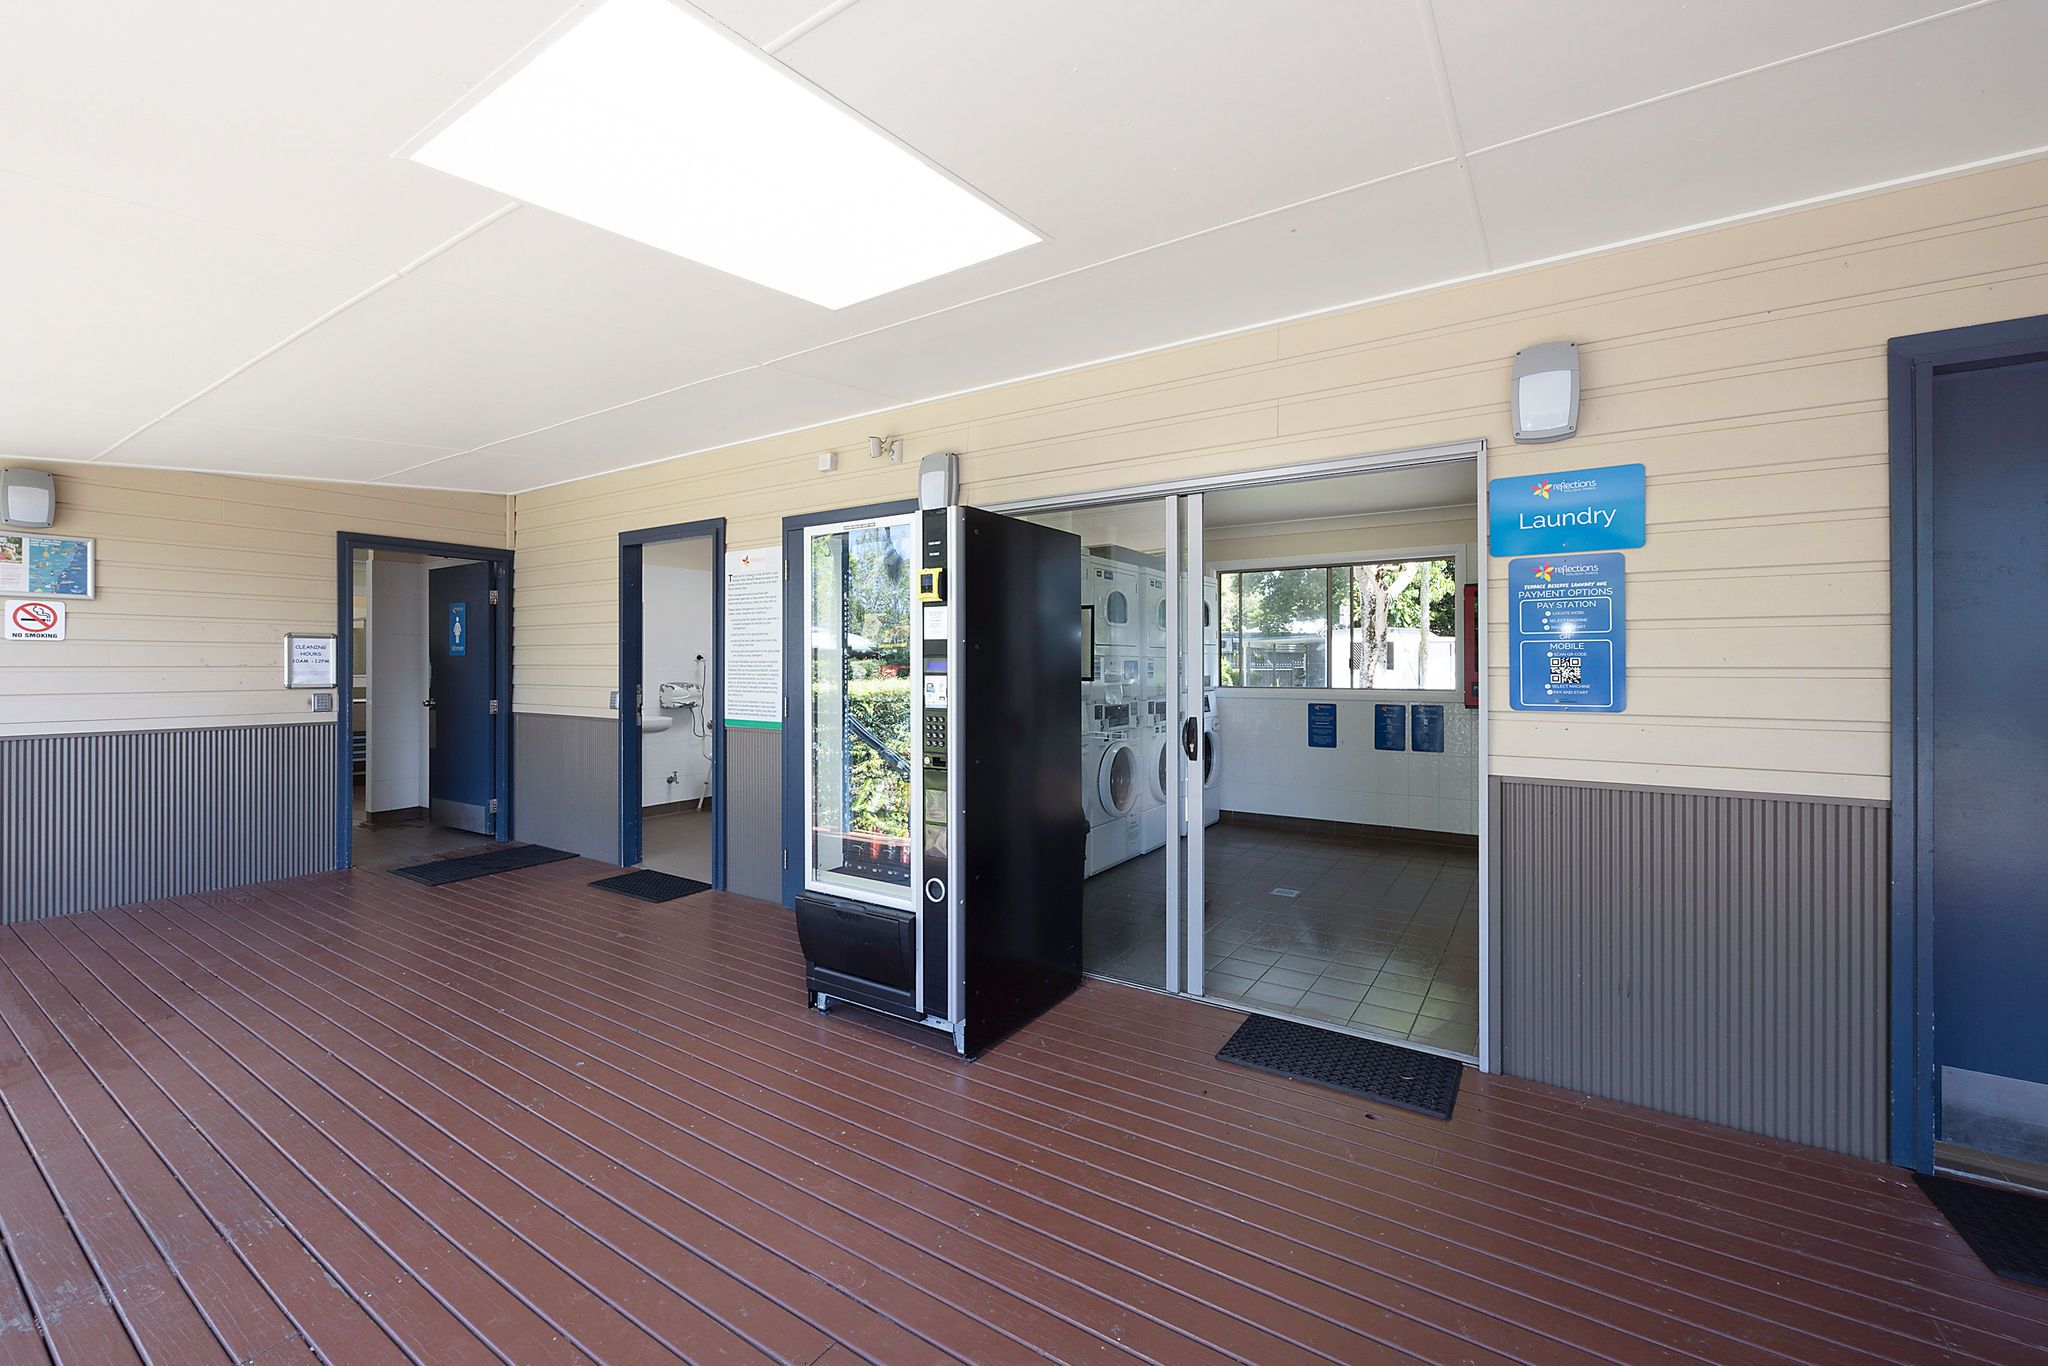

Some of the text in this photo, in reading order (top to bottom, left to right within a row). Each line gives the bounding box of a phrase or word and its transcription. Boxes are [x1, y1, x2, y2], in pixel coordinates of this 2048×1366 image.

[1553, 479, 1597, 492] reflections
[1519, 506, 1616, 530] Laundry
[1554, 563, 1599, 575] reflections
[1518, 587, 1613, 598] PAYMENT OPTIONS
